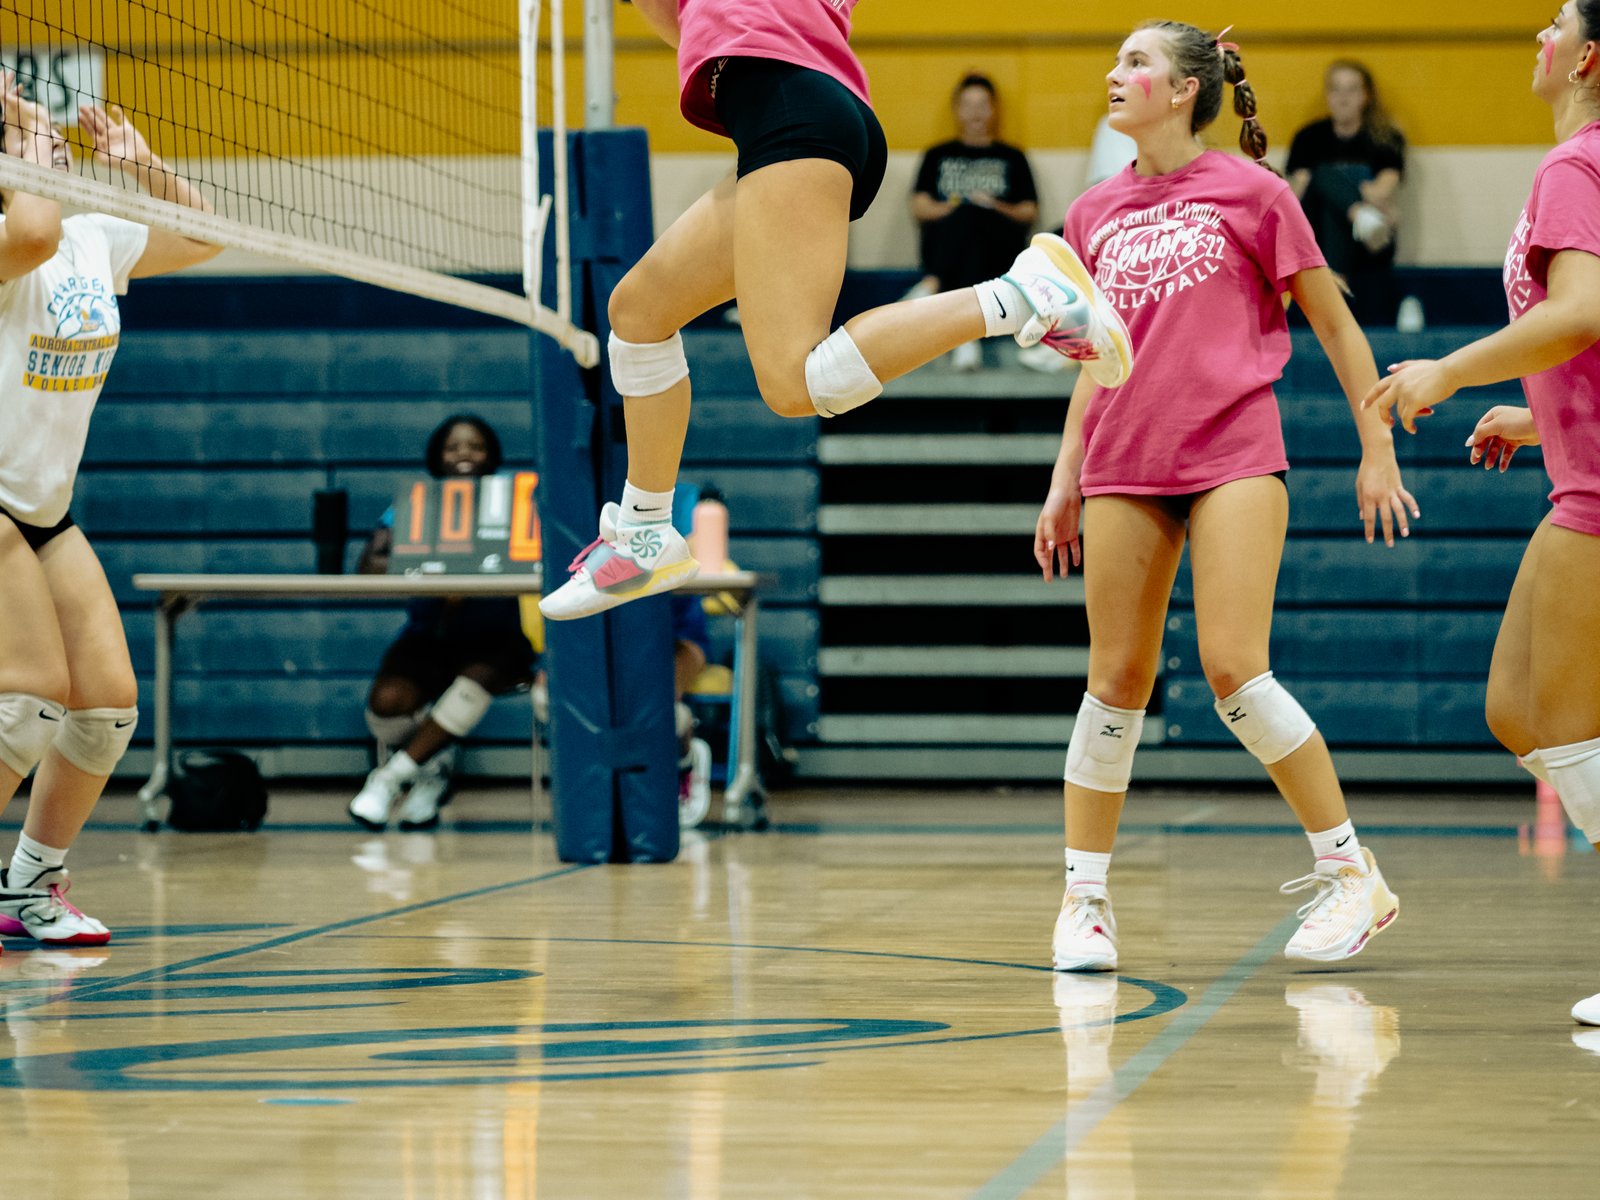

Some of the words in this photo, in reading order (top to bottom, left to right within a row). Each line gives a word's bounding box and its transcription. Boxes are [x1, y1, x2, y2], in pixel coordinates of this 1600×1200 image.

[1101, 223, 1205, 290] Seniors
[31, 335, 74, 352] AURORA
[27, 350, 87, 377] SENIOR
